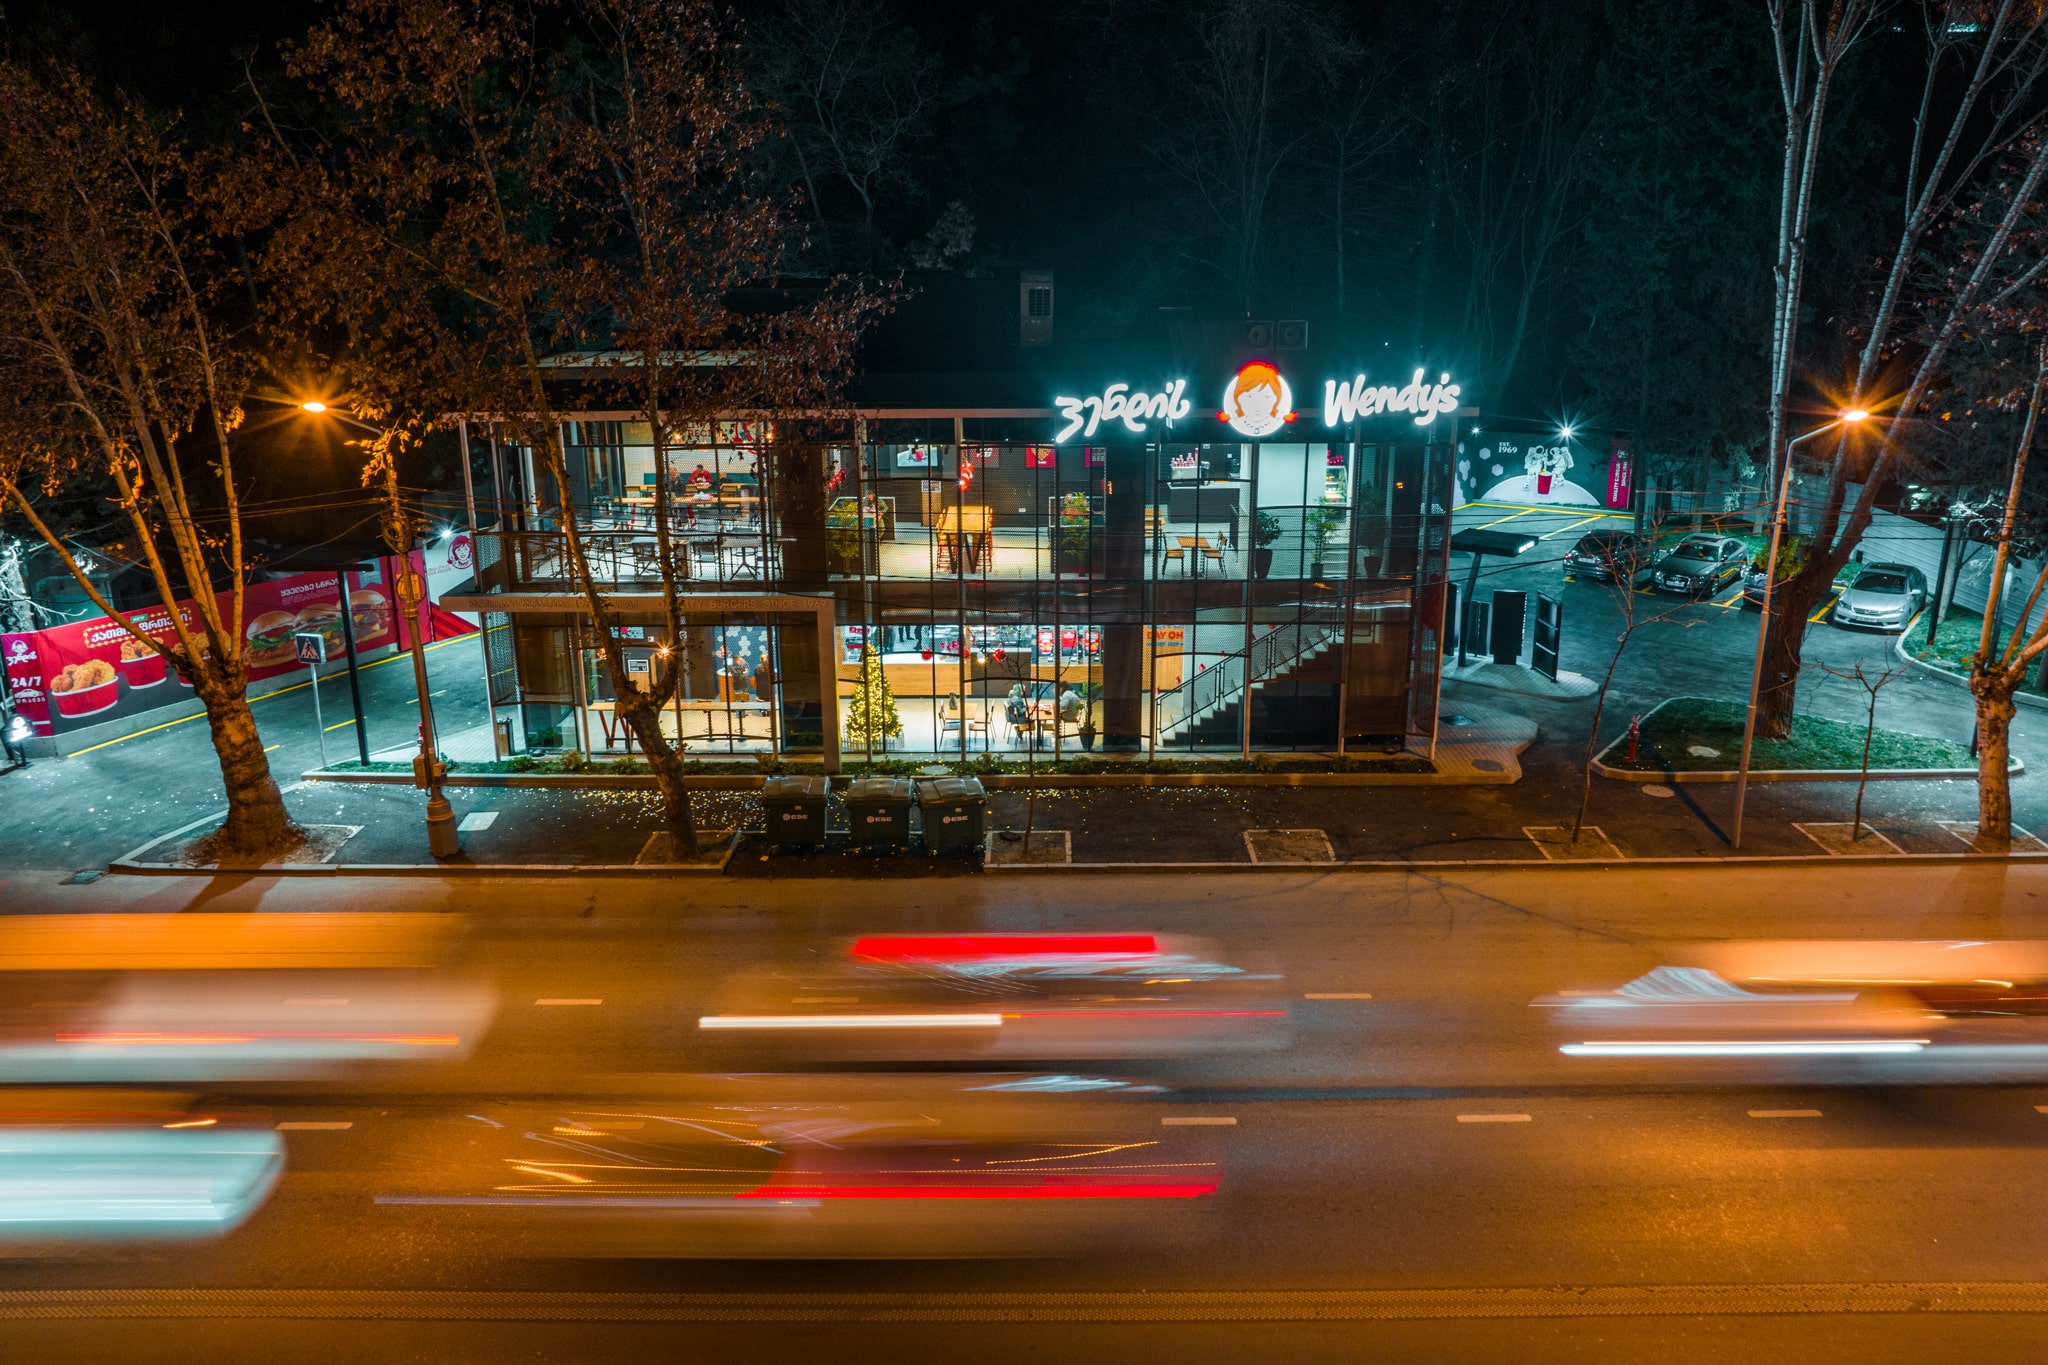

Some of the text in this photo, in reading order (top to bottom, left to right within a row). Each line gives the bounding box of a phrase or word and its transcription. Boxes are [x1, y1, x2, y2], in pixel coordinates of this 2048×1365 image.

[1324, 368, 1461, 428] Wendy's
[1498, 446, 1518, 454] 1969
[710, 599, 757, 609] BURGERS
[764, 599, 796, 609] SINCE
[803, 599, 827, 608] 1969
[91, 613, 189, 642] ქათმი ფრთეი
[1168, 631, 1184, 639] ON
[11, 676, 42, 688] 24/7
